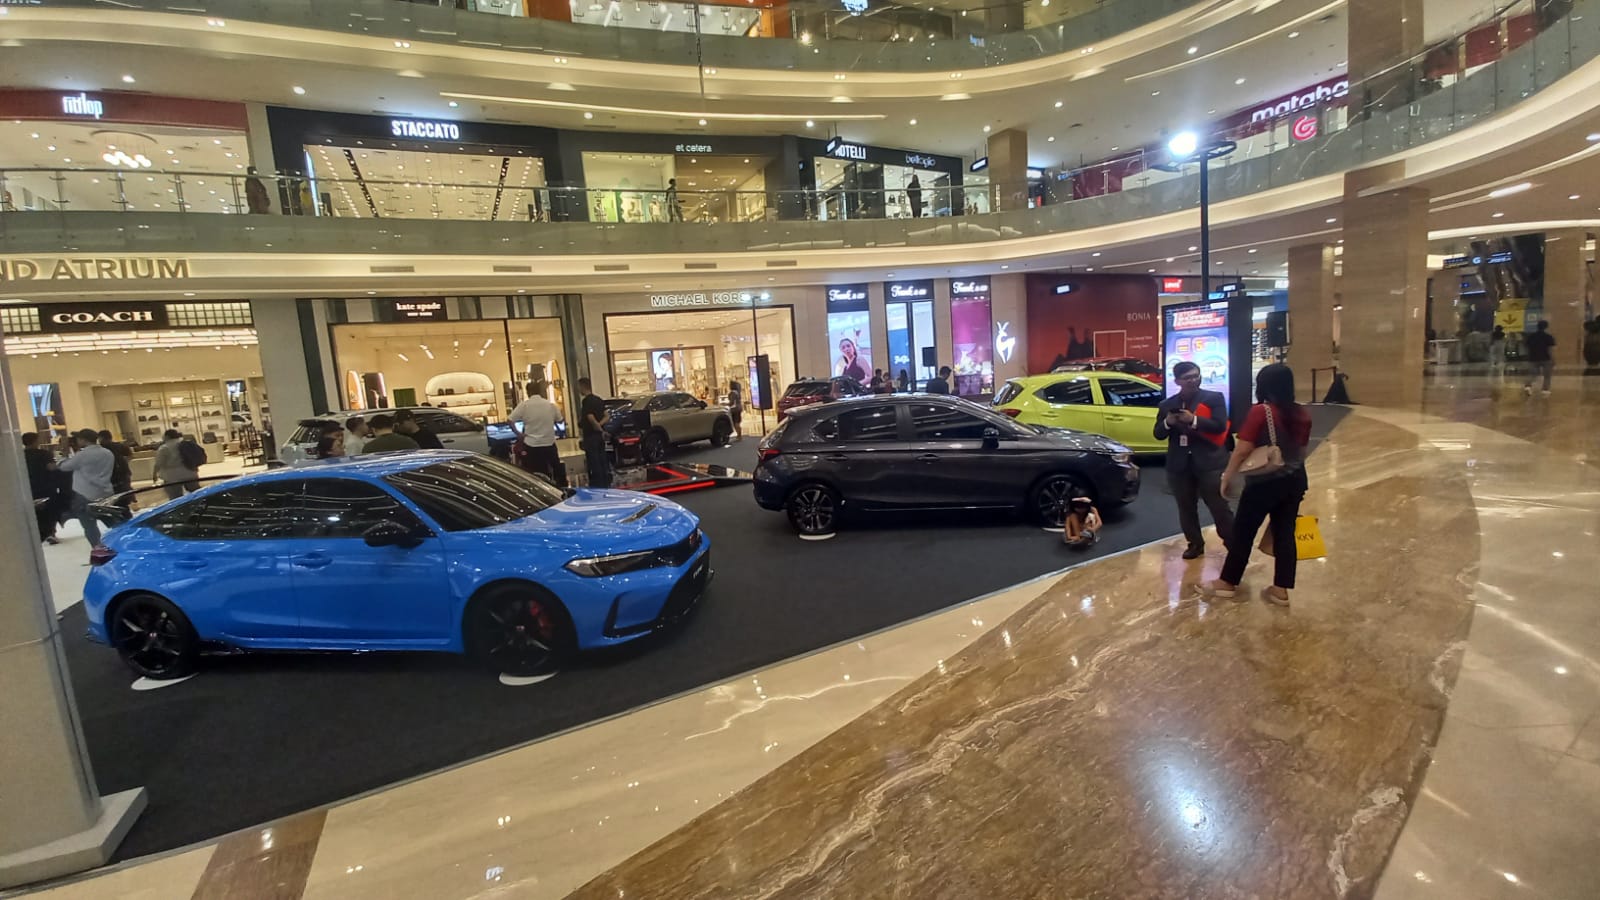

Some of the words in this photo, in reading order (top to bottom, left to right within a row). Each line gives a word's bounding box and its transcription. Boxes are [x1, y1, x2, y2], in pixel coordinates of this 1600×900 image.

[391, 120, 460, 140] STACCATO
[51, 258, 189, 280] ATRIUM
[651, 294, 709, 307] MICHAEL
[52, 311, 153, 324] COACH
